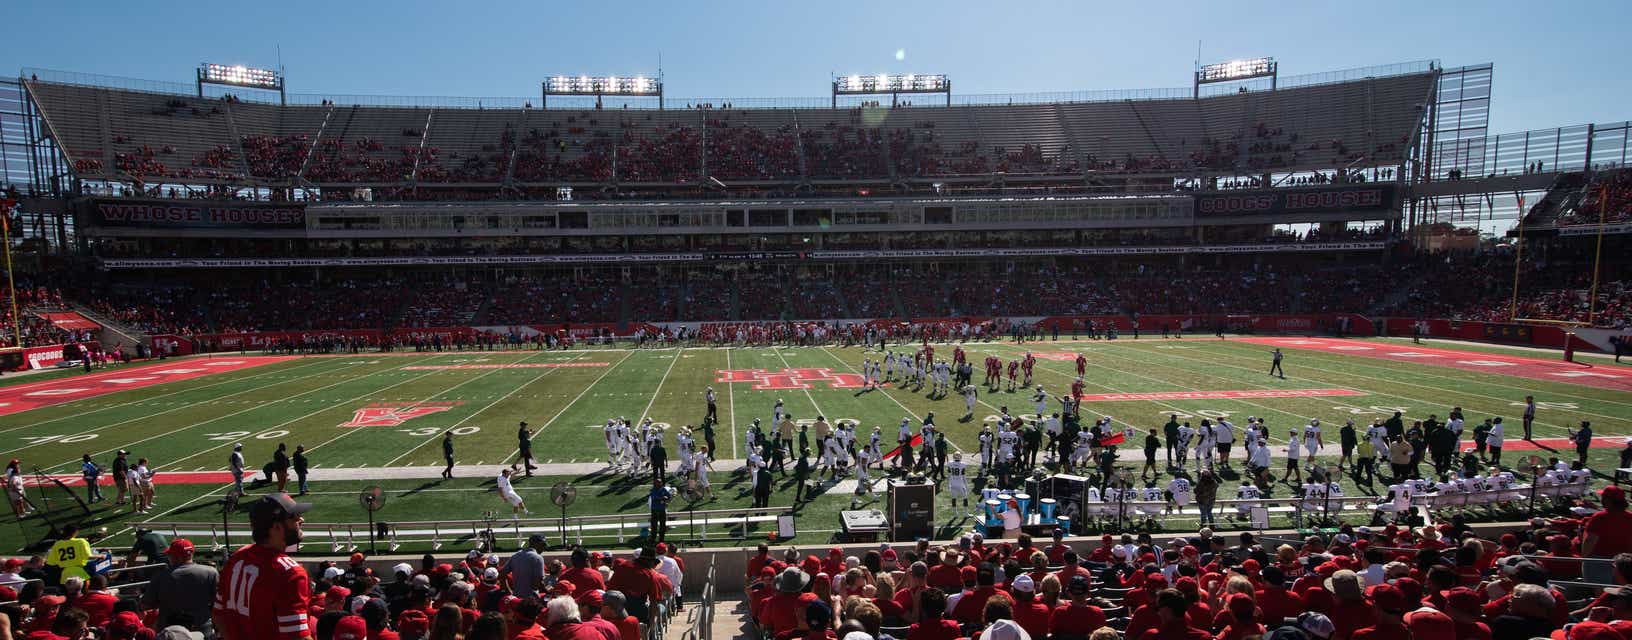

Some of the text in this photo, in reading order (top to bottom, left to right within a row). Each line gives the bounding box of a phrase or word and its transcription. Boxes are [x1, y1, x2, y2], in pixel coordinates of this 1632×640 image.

[1200, 190, 1382, 214] COOGS' HOUSE!
[98, 204, 304, 224] WHOSE HOUSE?
[206, 431, 290, 440] 20
[406, 426, 481, 437] 30
[951, 467, 960, 476] 18
[1402, 490, 1408, 500] 4
[58, 546, 76, 562] 29
[276, 554, 299, 570] 10
[226, 559, 259, 617] 10
